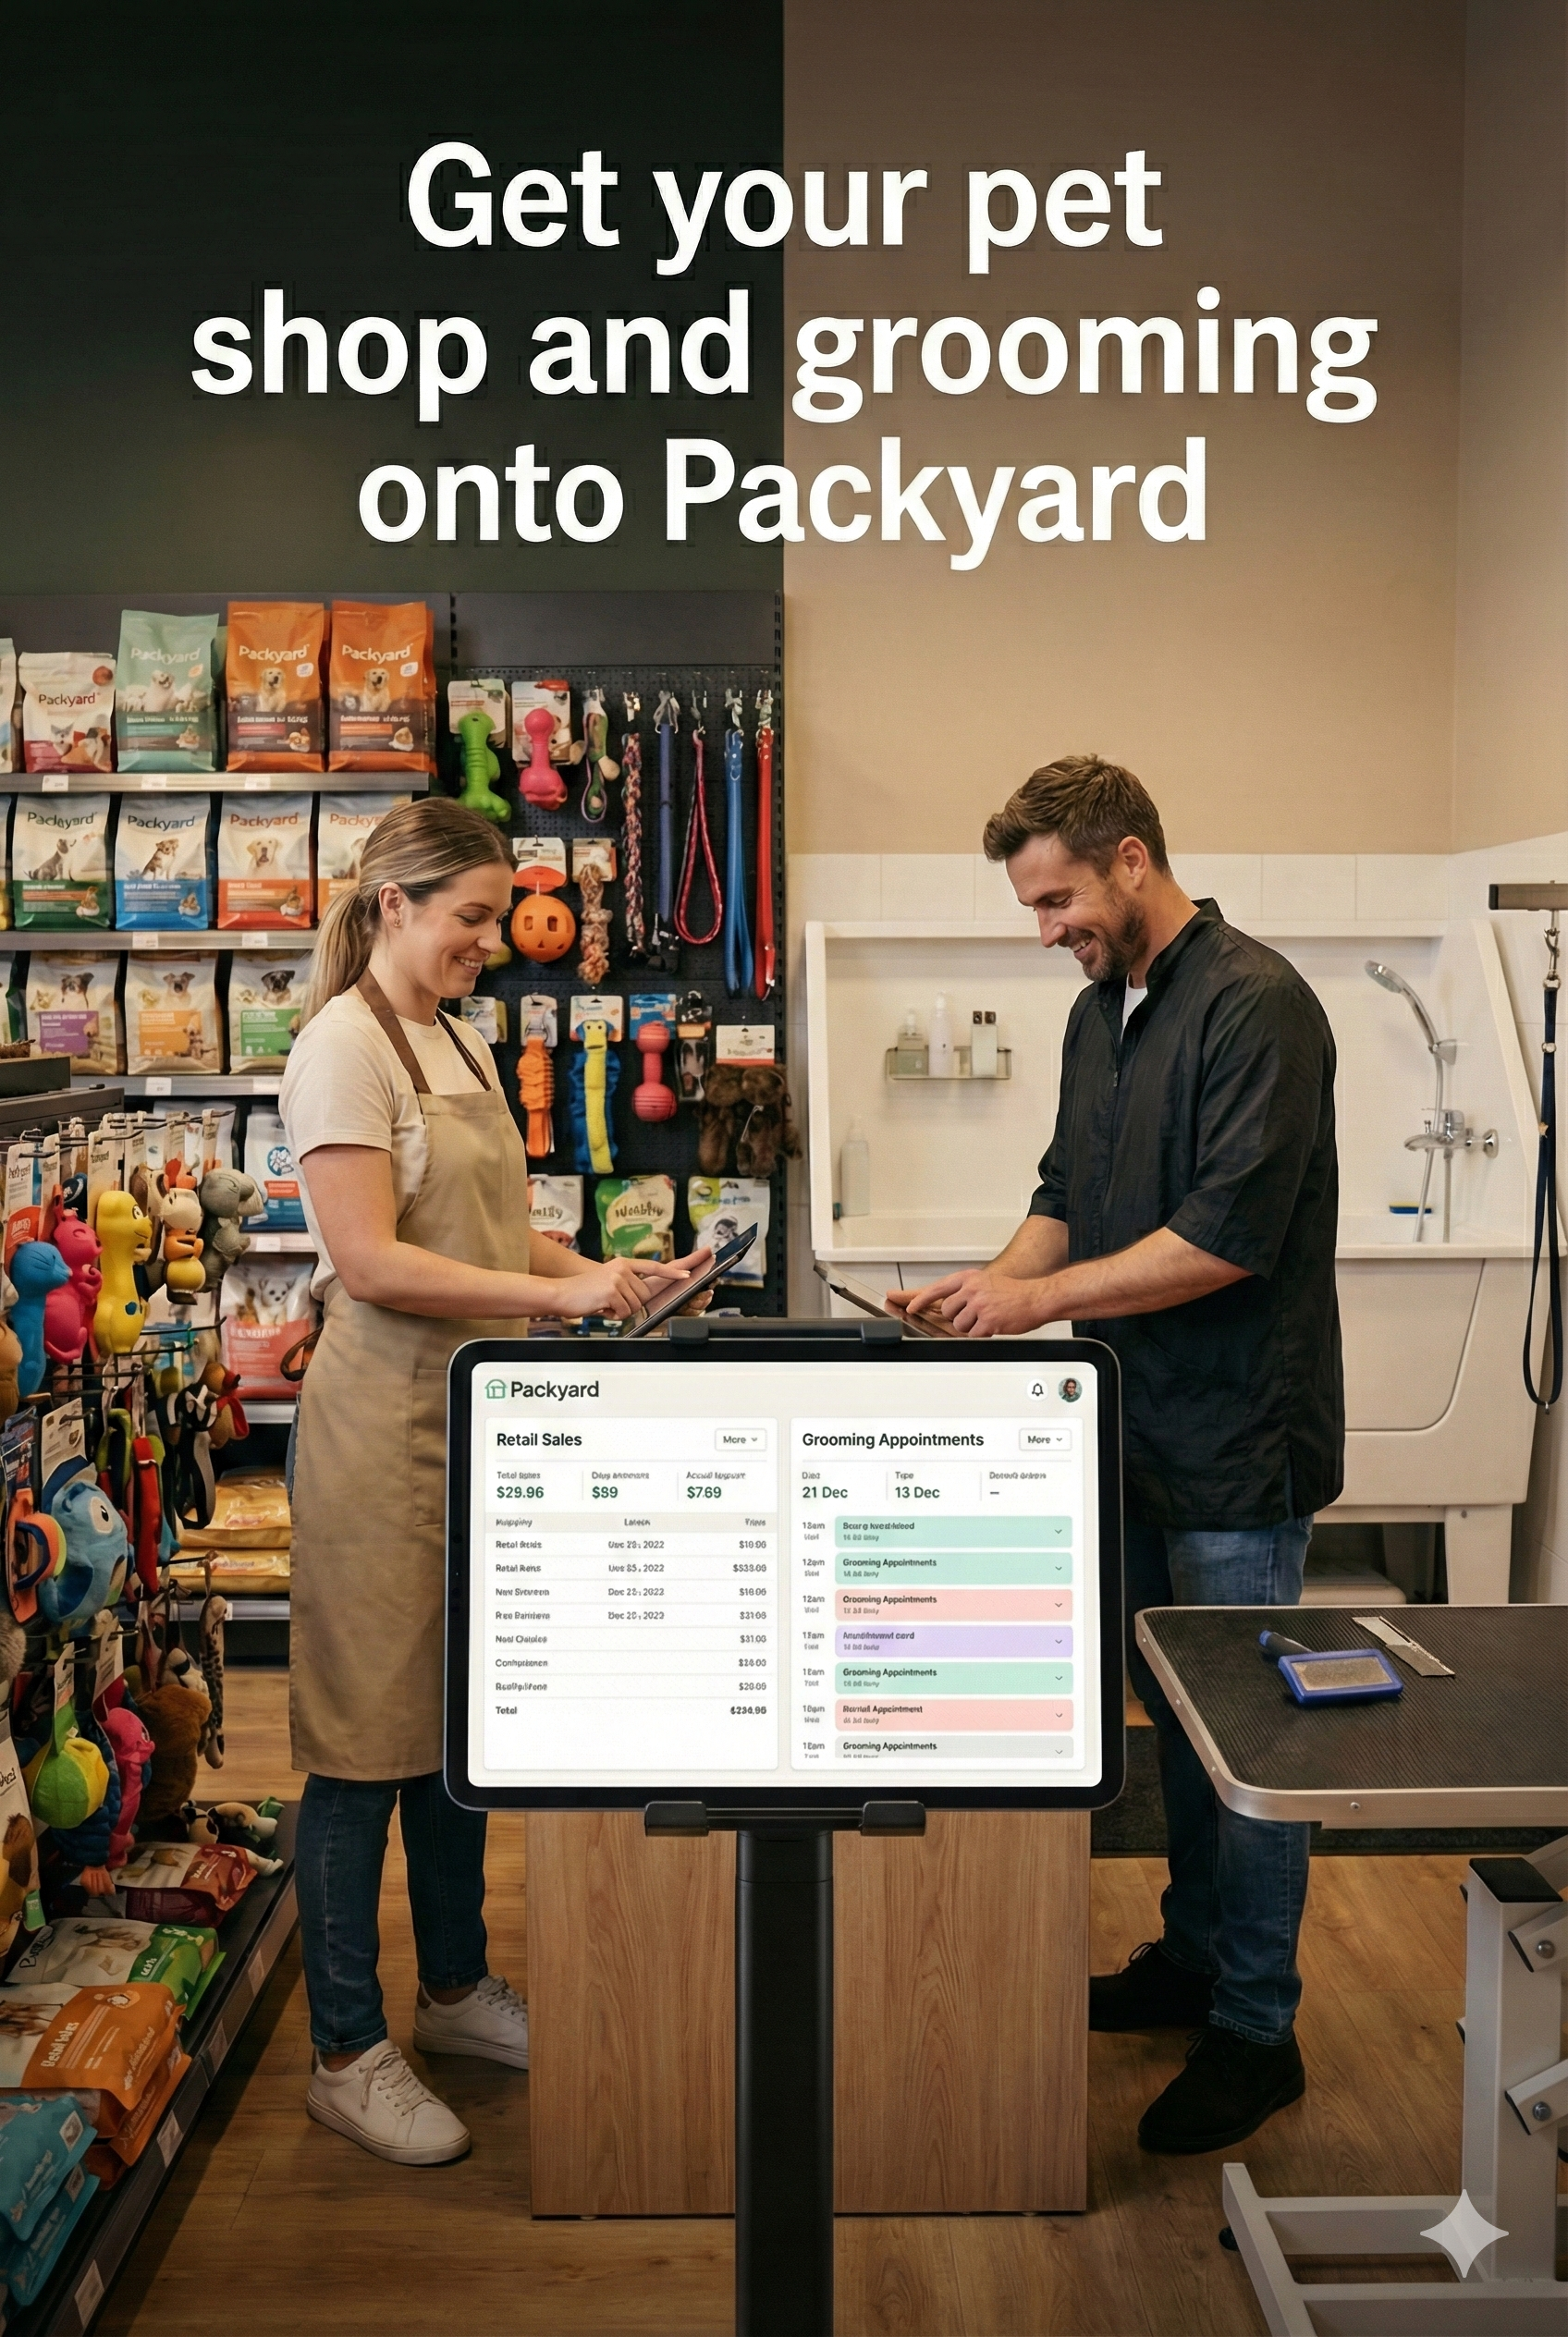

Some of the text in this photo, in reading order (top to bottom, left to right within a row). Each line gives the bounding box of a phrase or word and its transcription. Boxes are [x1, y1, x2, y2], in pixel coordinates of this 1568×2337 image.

[239, 644, 308, 664] Packyard
[342, 644, 411, 664] Packyard
[38, 692, 96, 707] Packyard
[128, 814, 195, 831] Packyard
[230, 814, 299, 828] Packyard
[510, 1379, 600, 1402] Packyard
[496, 1432, 582, 1447] Retail Sales
[802, 1432, 985, 1450] Grooming Appointments
[802, 1486, 849, 1499] 21 Dec
[894, 1486, 941, 1499] 13 Dec
